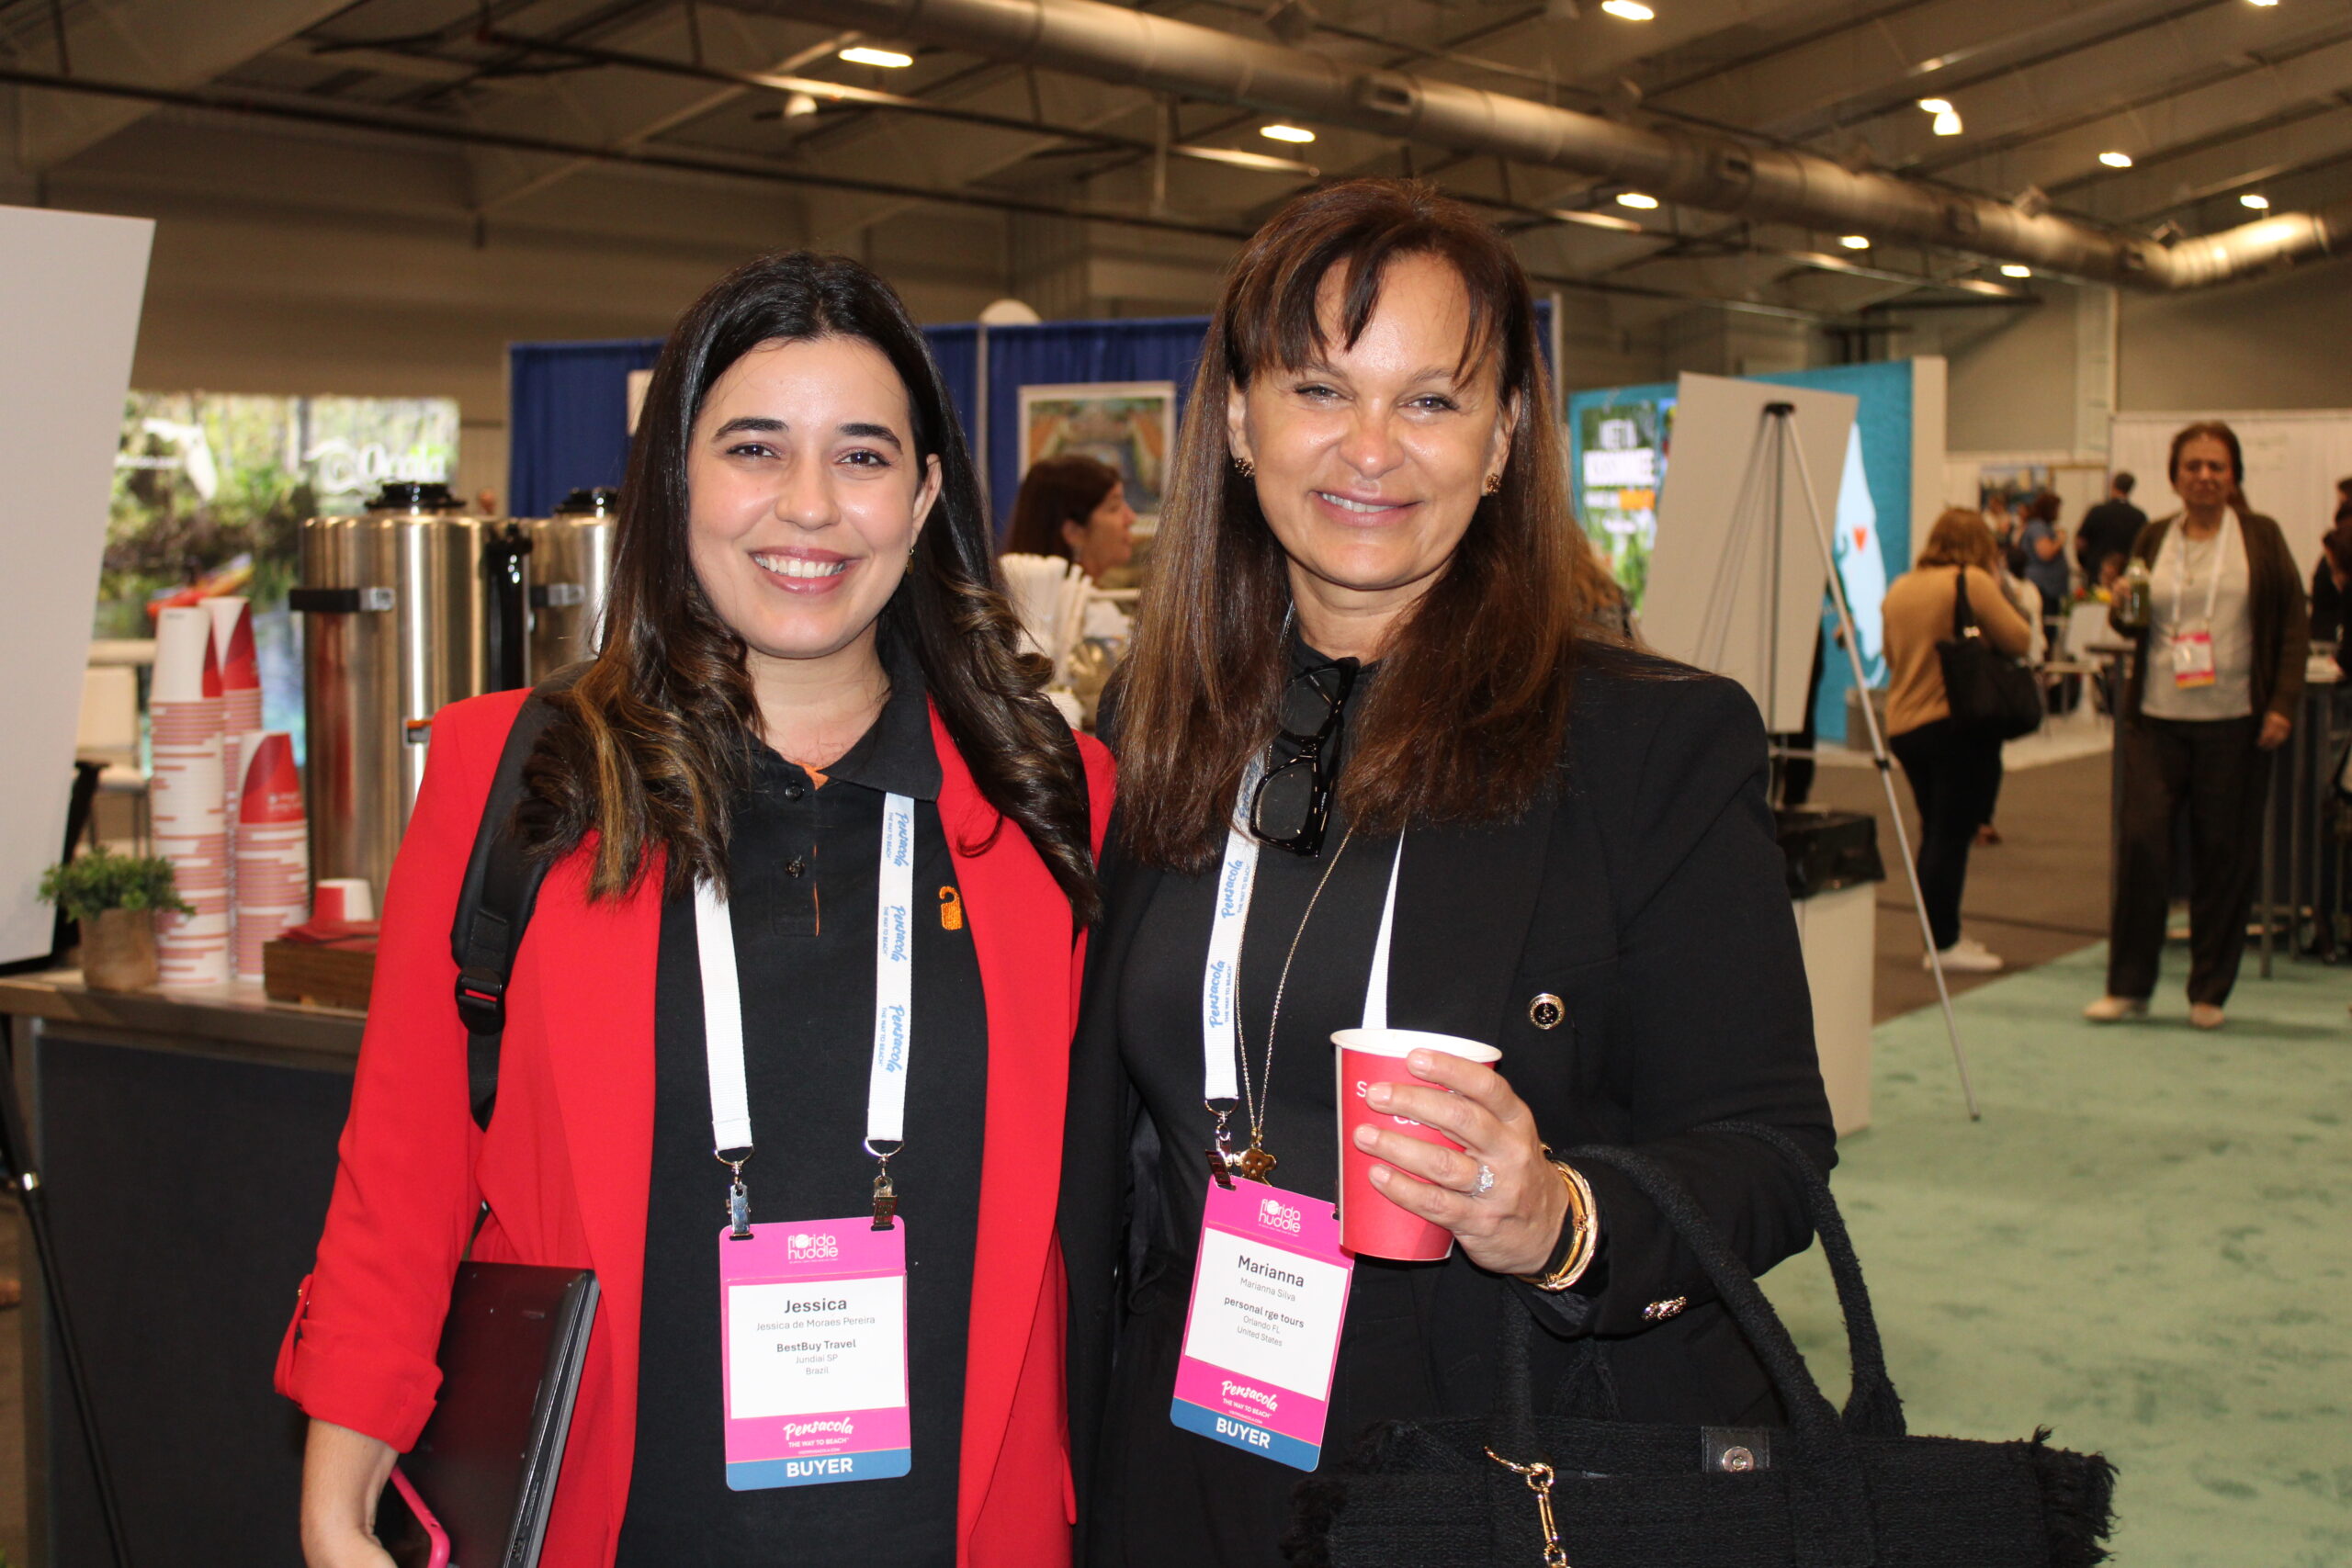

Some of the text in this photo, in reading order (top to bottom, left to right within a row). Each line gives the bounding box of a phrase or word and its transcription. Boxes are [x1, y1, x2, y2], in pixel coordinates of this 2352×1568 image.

[894, 812, 910, 867] Pensacola
[1221, 860, 1243, 919] Pensacola
[890, 906, 908, 962] Pensacola
[1208, 960, 1226, 1028] Pensacola
[886, 1004, 905, 1072] Pensacola
[1258, 1212, 1301, 1233] huddle
[787, 1245, 839, 1260] huddle
[1238, 1255, 1305, 1288] Marianna
[1239, 1277, 1295, 1302] Marianna Silva
[784, 1297, 847, 1314] Jessica
[1224, 1296, 1305, 1328] personal rge tours
[792, 1320, 804, 1329] de
[807, 1318, 841, 1328] Moraes
[842, 1315, 876, 1325] Pereira
[1243, 1314, 1281, 1334] Orlando FL
[776, 1338, 856, 1353] BestBuy Travel
[1237, 1325, 1283, 1347] United States
[826, 1353, 838, 1362] SP
[806, 1366, 829, 1375] Brazil
[1221, 1380, 1278, 1412] Pensacola
[1222, 1397, 1233, 1407] THE
[1244, 1404, 1252, 1413] TO
[783, 1416, 854, 1441] Pensacola
[1216, 1416, 1271, 1450] BUYER
[786, 1457, 854, 1478] BUYER
